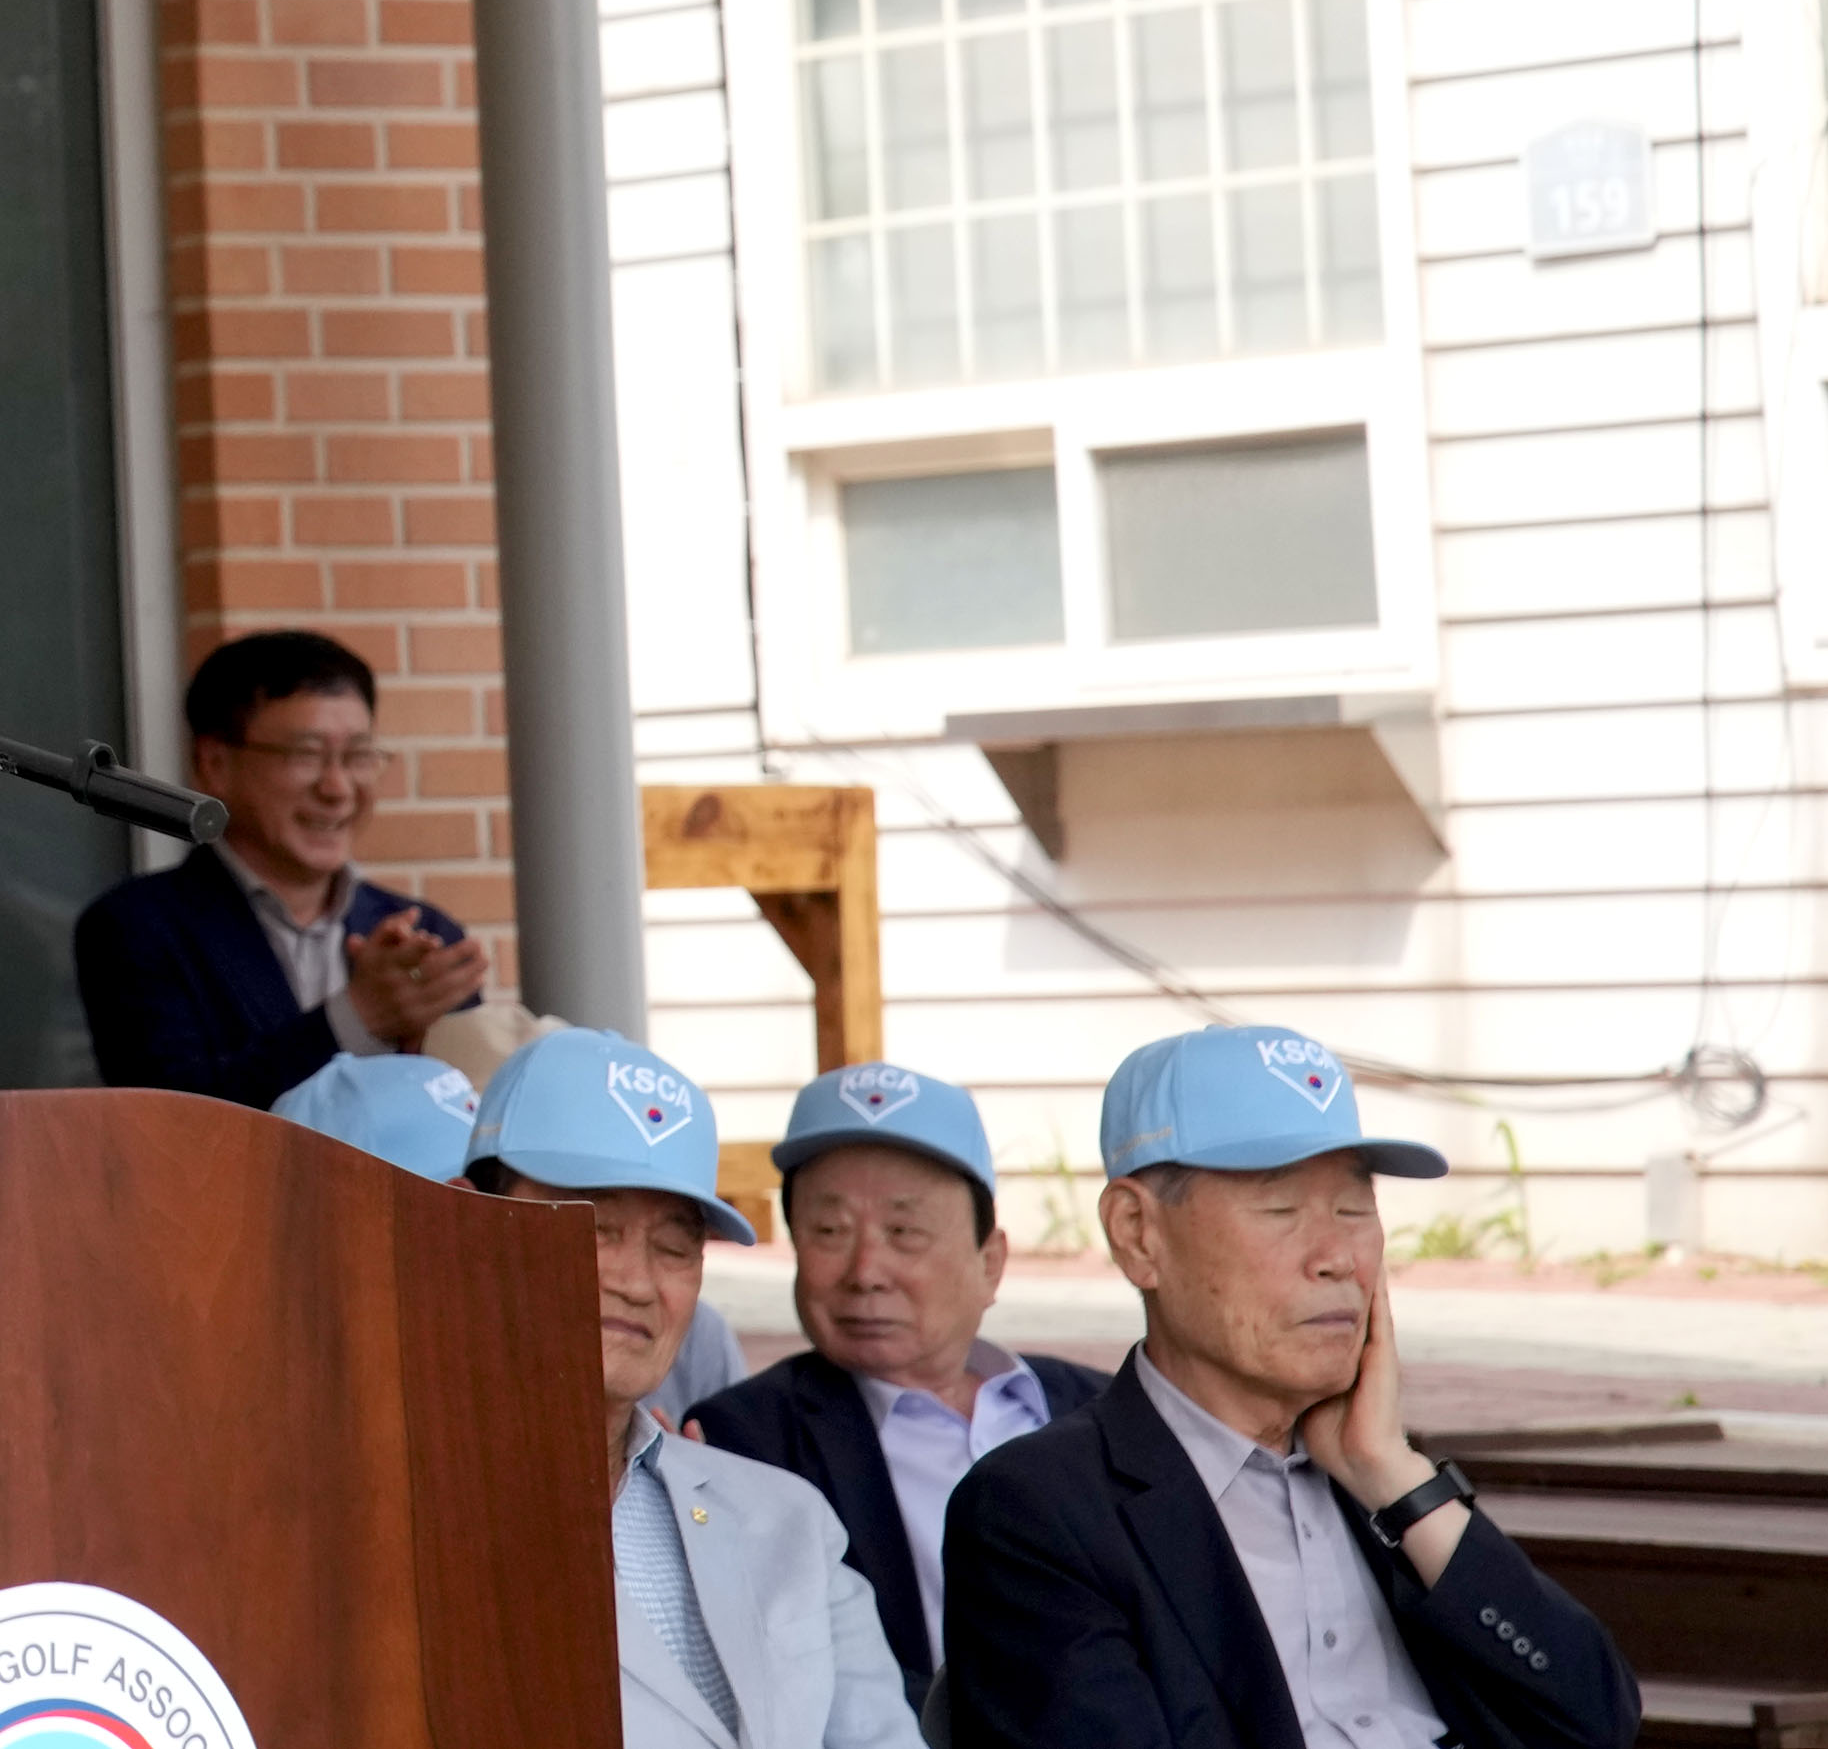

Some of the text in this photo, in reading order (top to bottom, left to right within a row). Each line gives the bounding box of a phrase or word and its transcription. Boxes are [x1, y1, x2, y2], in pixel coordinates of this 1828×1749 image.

[1549, 176, 1630, 234] 159
[1256, 1039, 1340, 1074] KSCA
[609, 1061, 692, 1116] KSCA
[840, 1067, 920, 1093] KSCA
